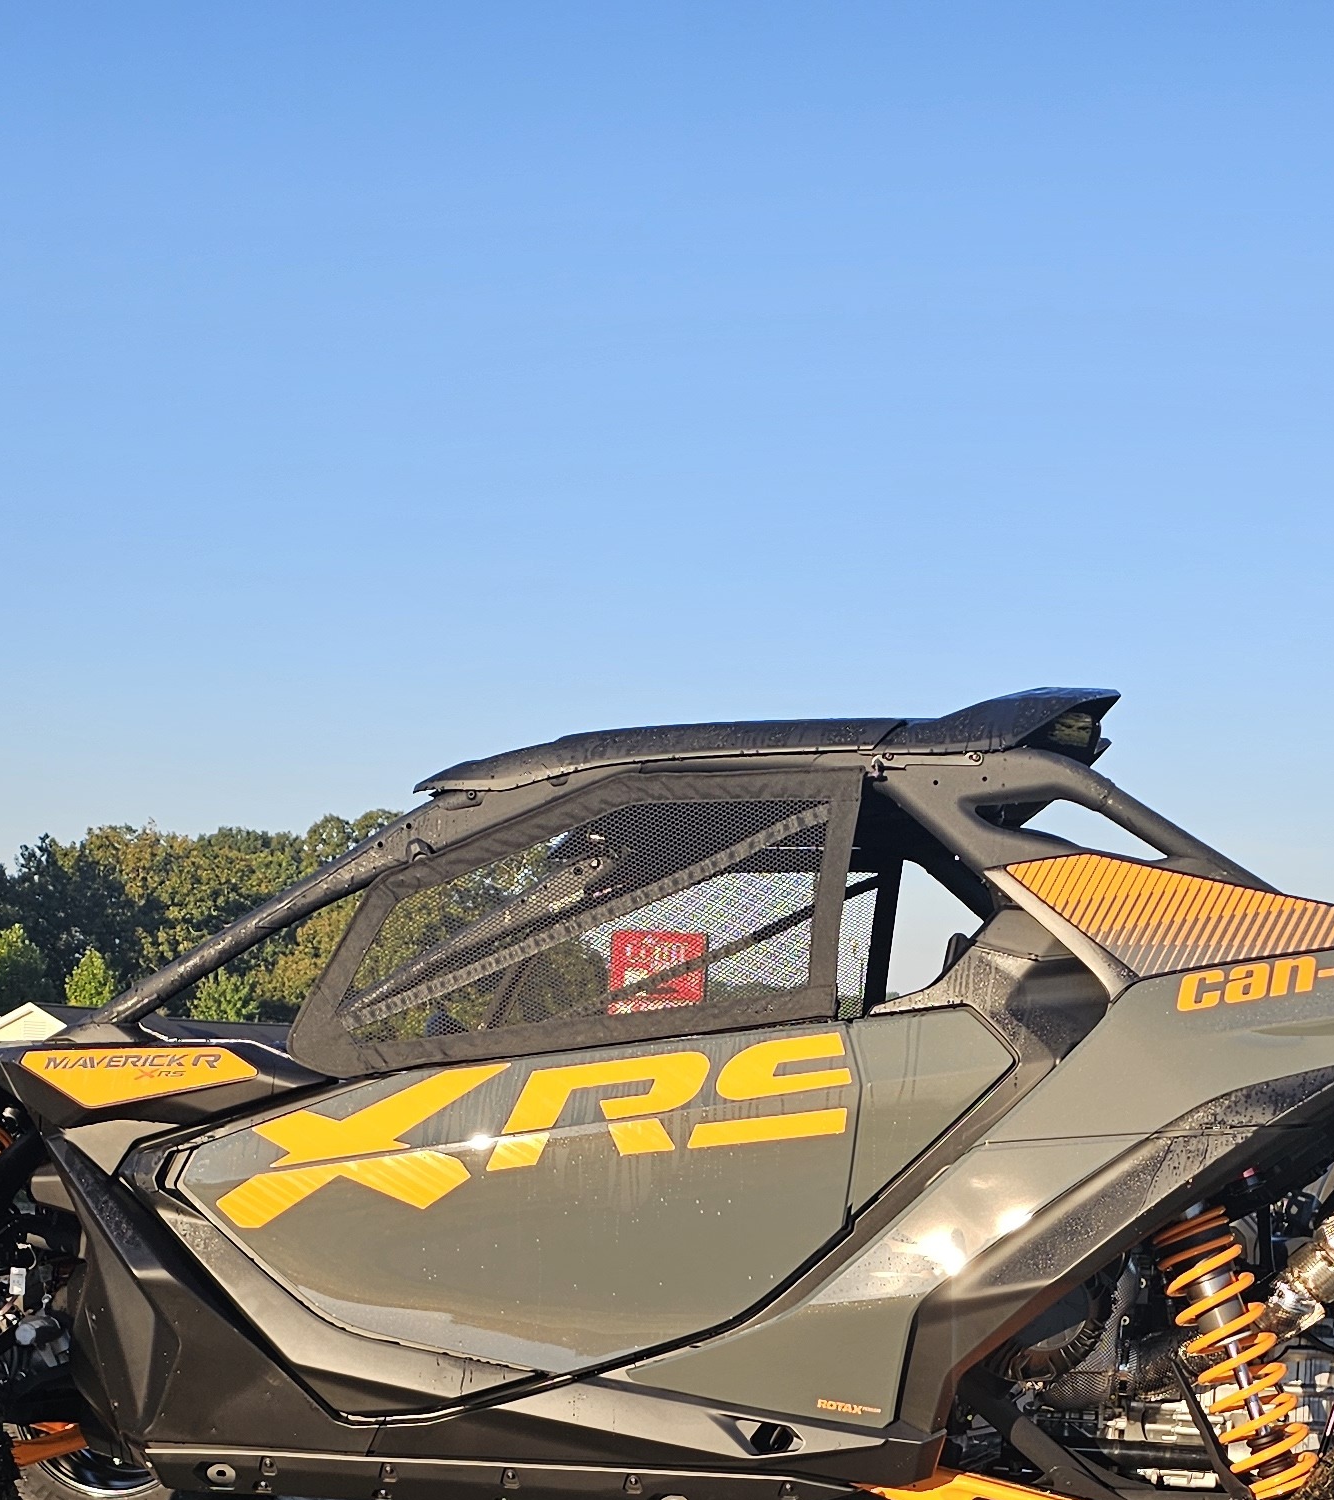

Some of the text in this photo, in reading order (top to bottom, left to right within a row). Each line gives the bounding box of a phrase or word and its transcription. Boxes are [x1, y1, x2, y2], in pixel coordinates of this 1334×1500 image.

[44, 1053, 222, 1070] MAVERICK R
[134, 1068, 186, 1080] XRS
[216, 1032, 852, 1228] XRS
[817, 1399, 863, 1415] ROTAX
